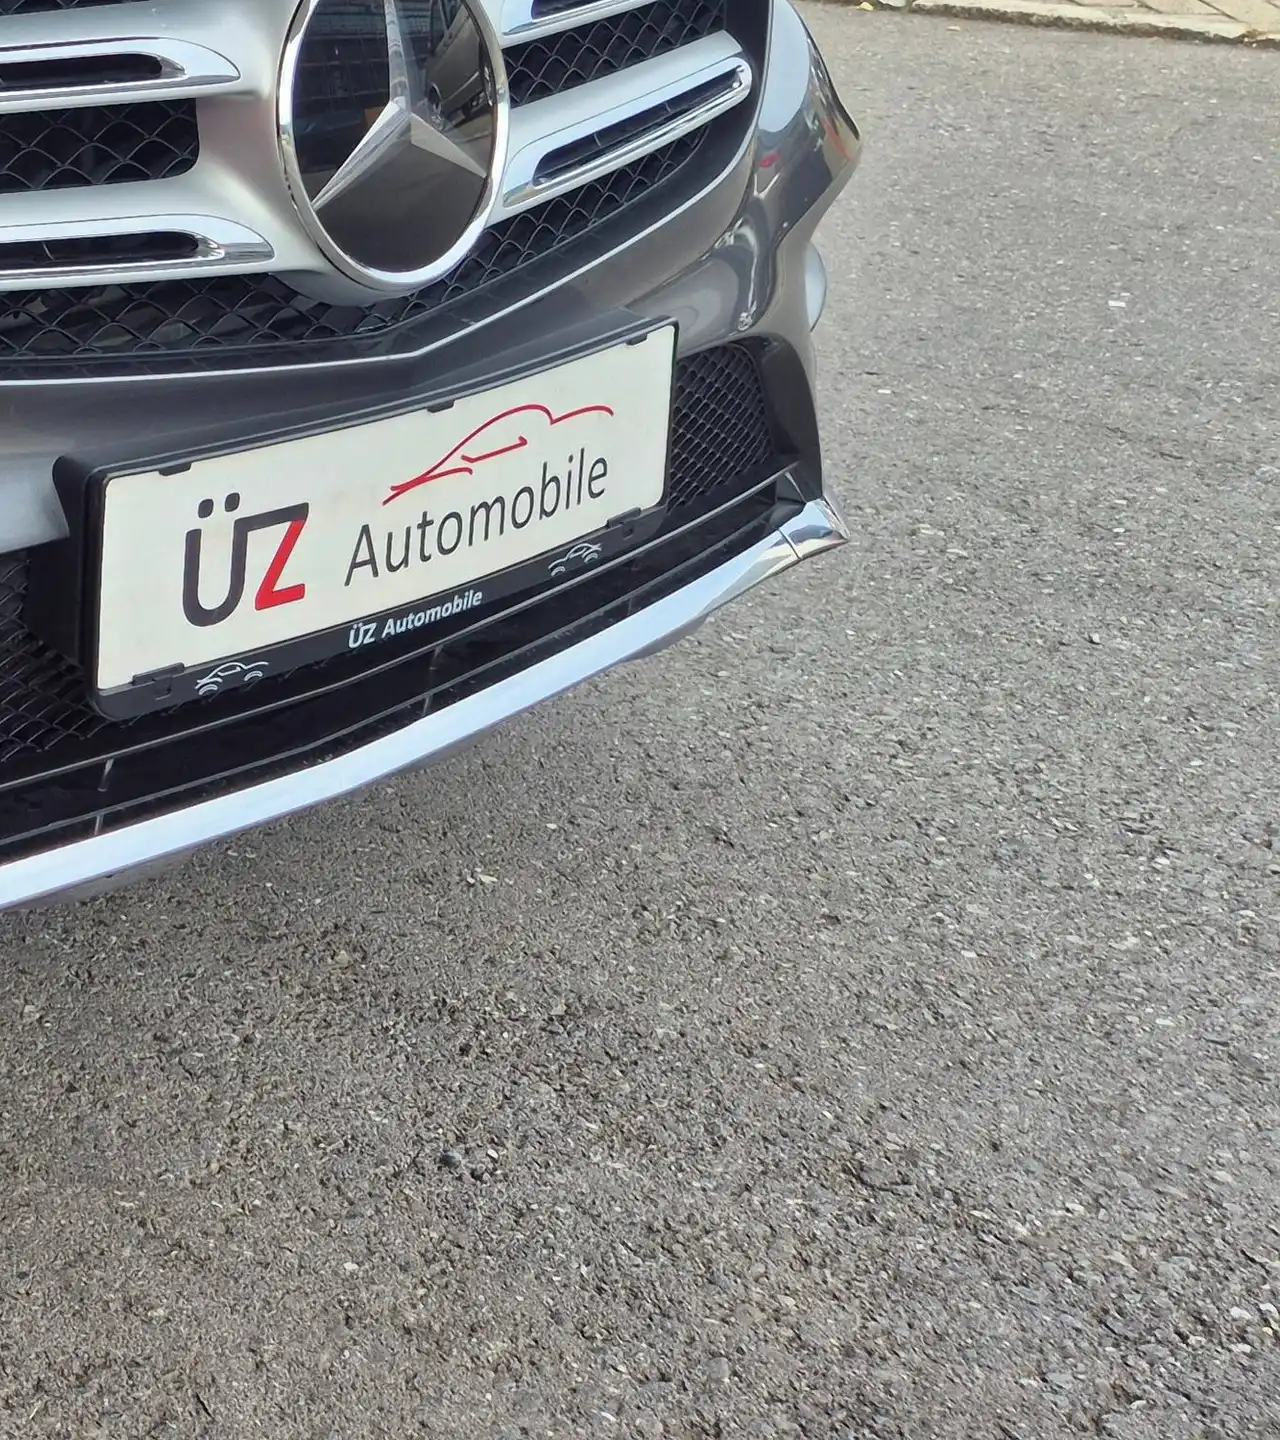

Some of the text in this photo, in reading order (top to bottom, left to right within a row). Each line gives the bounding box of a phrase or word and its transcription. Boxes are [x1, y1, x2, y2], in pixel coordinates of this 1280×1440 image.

[182, 492, 310, 628] ÜZ
[343, 447, 610, 587] Automobile
[348, 589, 483, 649] ÜZ Automobile
